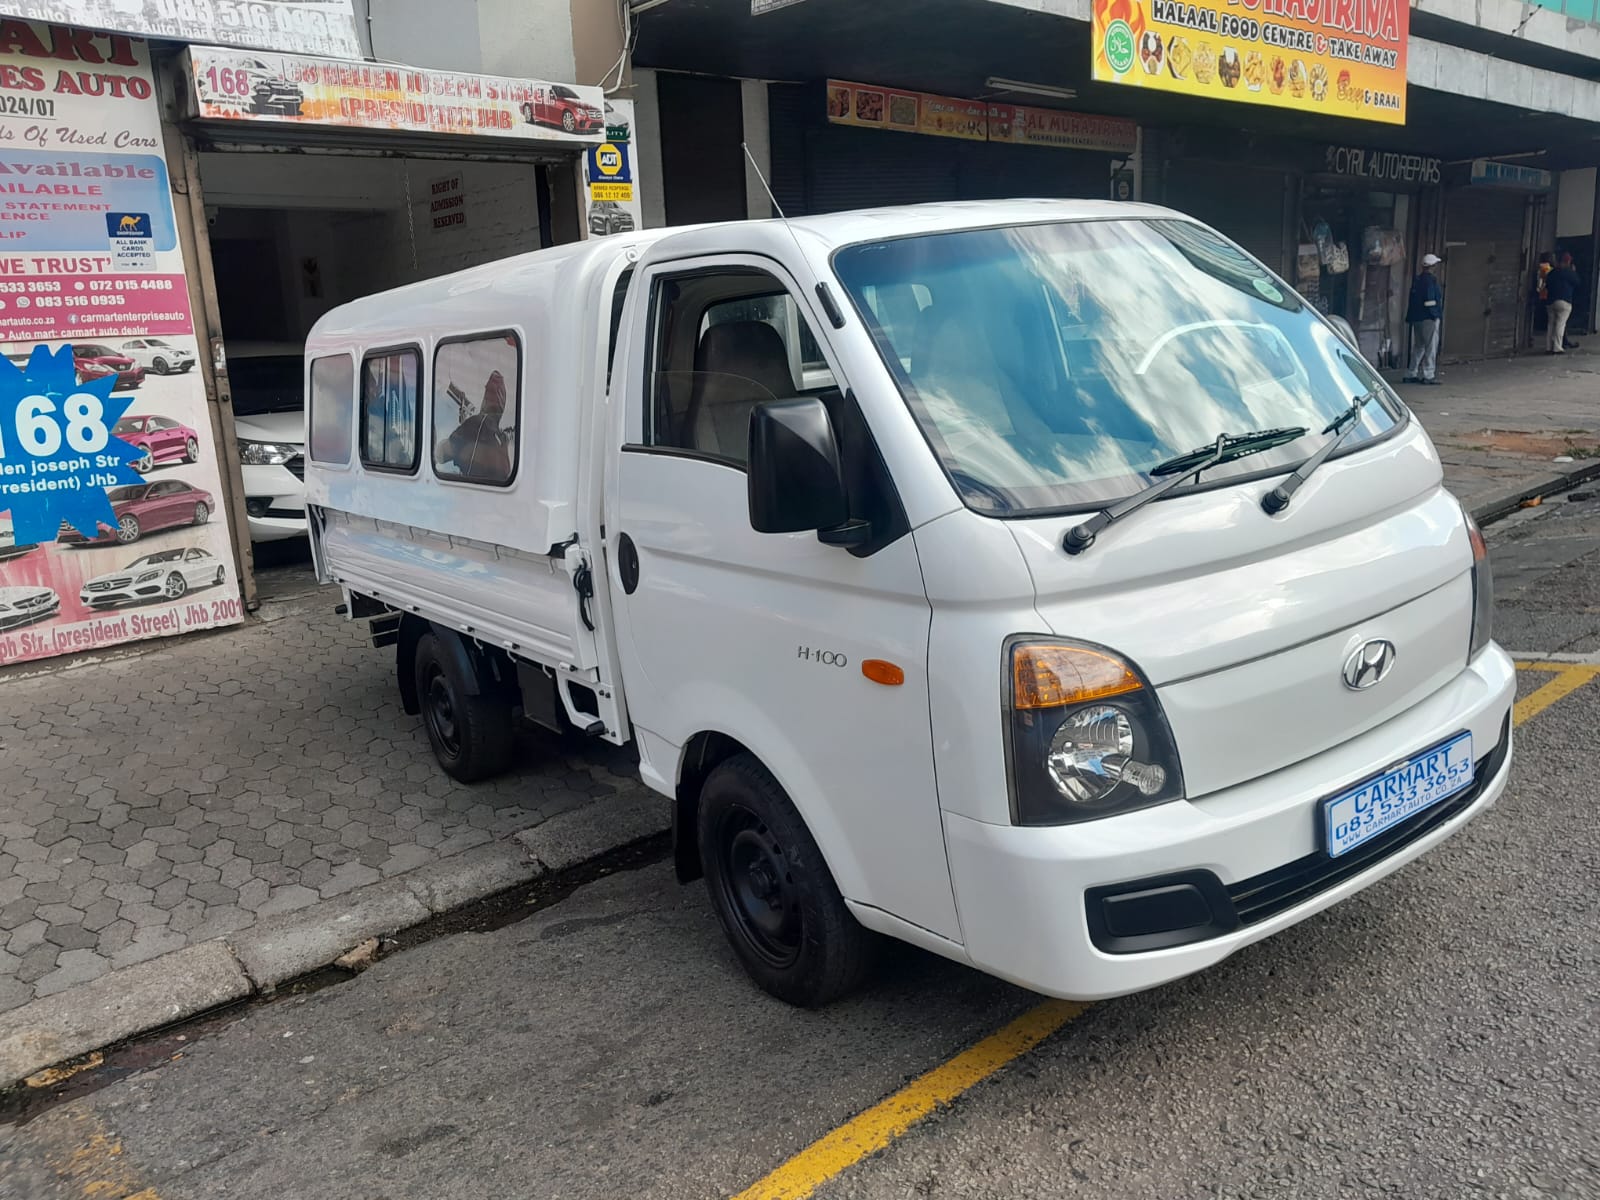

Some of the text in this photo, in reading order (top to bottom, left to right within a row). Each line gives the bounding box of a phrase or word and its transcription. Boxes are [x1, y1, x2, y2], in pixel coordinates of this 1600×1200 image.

[222, 2, 267, 31] 516
[0, 20, 139, 66] ART
[1152, 1, 1398, 69] HALAAL FOOD CENTRE & TAKE AWAY
[54, 70, 152, 99] AUTO
[206, 66, 249, 96] 168
[477, 108, 513, 130] JHB
[24, 125, 48, 147] Of
[56, 127, 107, 145] Used
[114, 130, 158, 148] Cars
[601, 153, 617, 165] ADT
[6, 202, 111, 211] STATEMENT
[90, 280, 112, 291] 072
[115, 280, 139, 290] 015
[140, 279, 172, 290] 4488
[35, 295, 125, 307] 083 516 0935
[80, 311, 185, 324] carmartenterpriseauto
[8, 330, 32, 340] Auto
[60, 327, 96, 338] carmart
[98, 327, 119, 336] auto
[121, 326, 148, 336] dealer
[0, 393, 109, 459] 68
[31, 457, 91, 476] joseph
[95, 454, 120, 468] Str
[0, 472, 118, 496] resident) Jhb
[22, 632, 49, 653] Str.
[52, 619, 128, 651] (president
[132, 608, 180, 636] Street)
[184, 605, 209, 626] Jhb
[212, 599, 244, 621] 2001
[1354, 746, 1453, 814] CARMART
[1336, 758, 1470, 840] 083 533 3653
